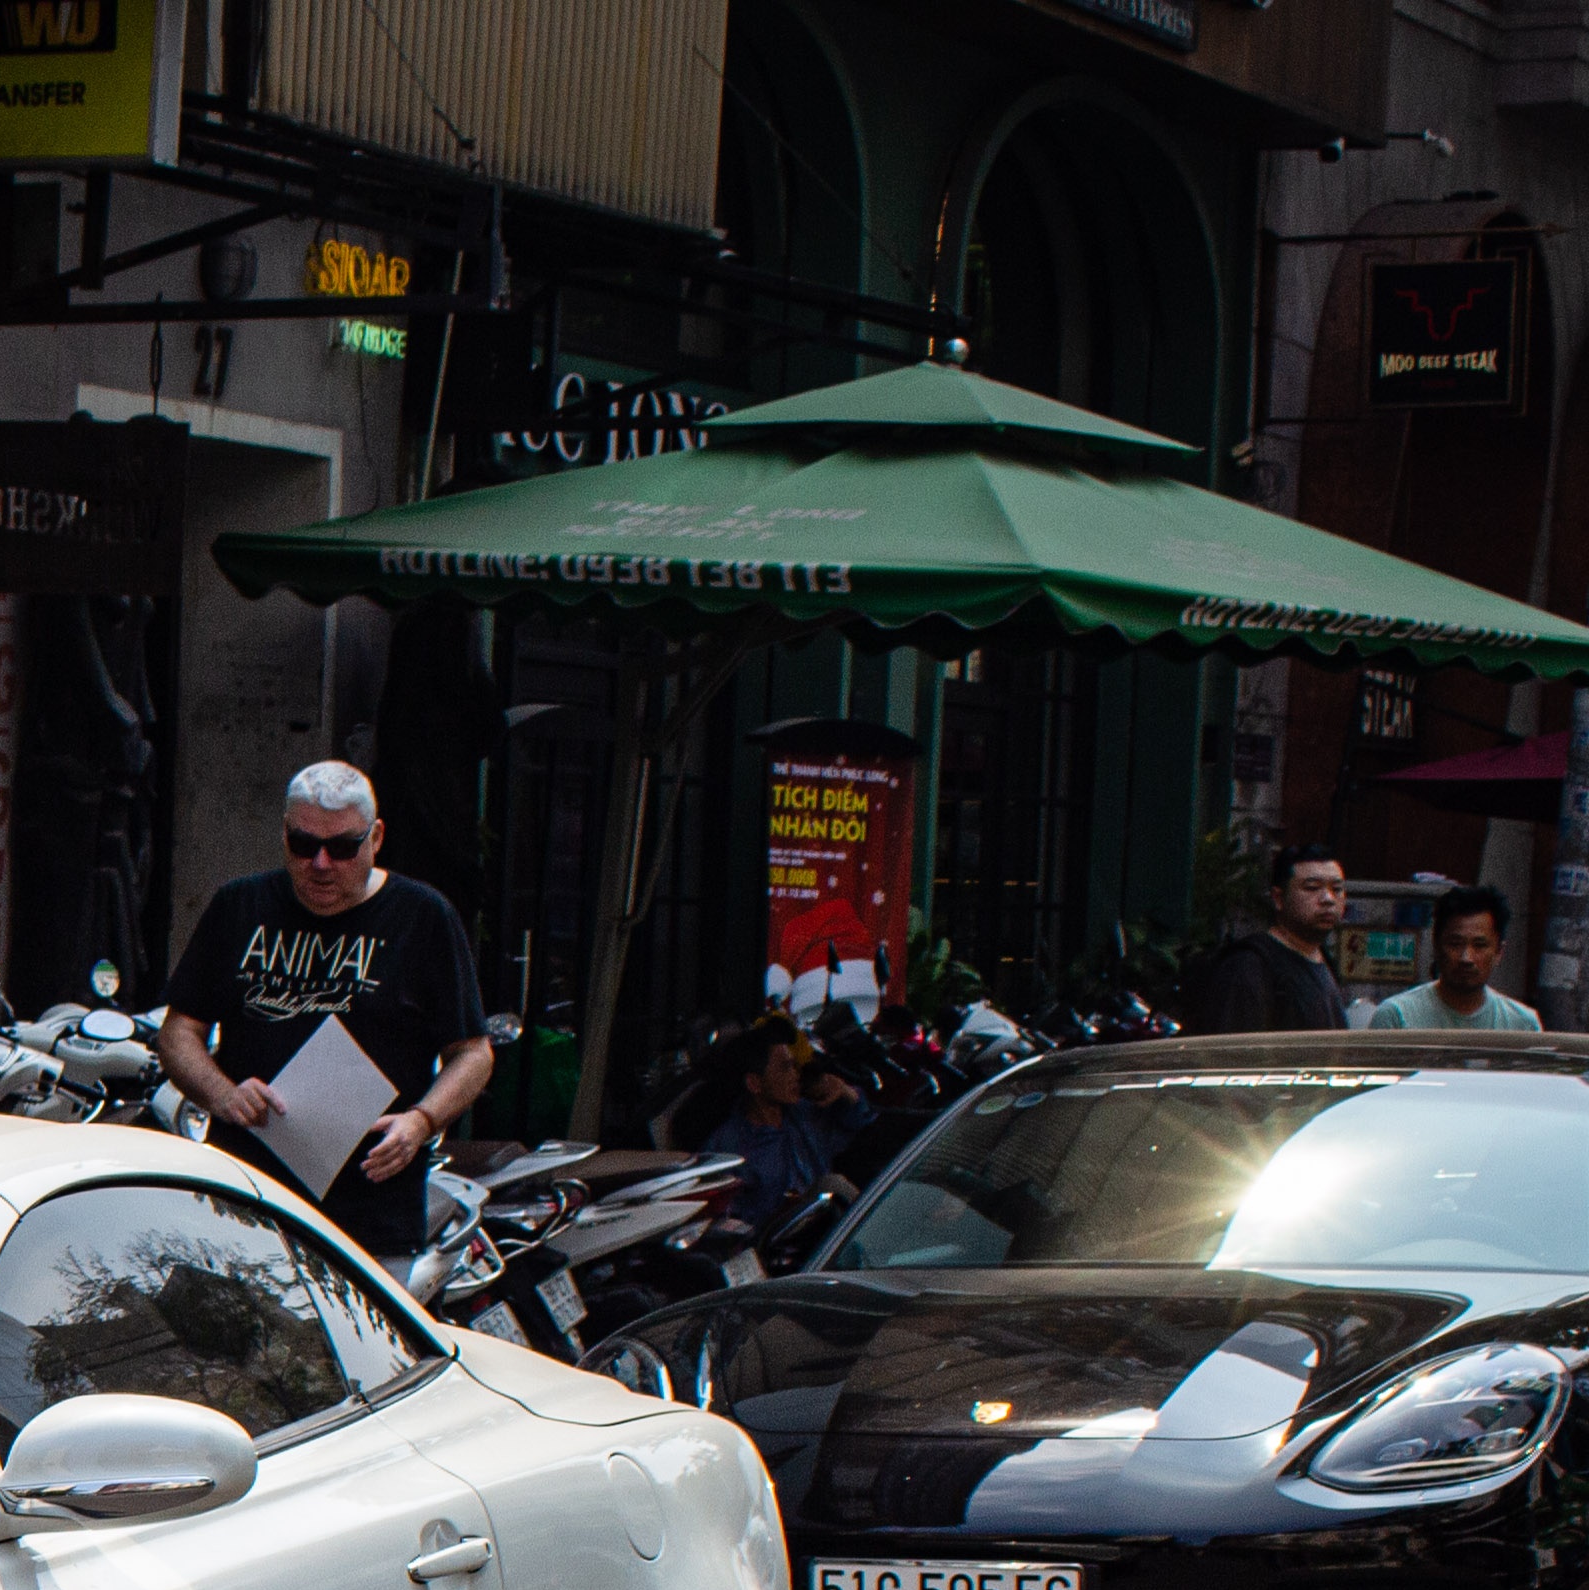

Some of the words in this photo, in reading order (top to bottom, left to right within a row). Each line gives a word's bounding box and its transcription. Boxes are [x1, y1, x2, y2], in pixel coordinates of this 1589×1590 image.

[1379, 352, 1416, 379] MOO
[1453, 347, 1498, 373] STEAK
[772, 781, 819, 810] TÍCH
[238, 923, 381, 985] ANIMAL
